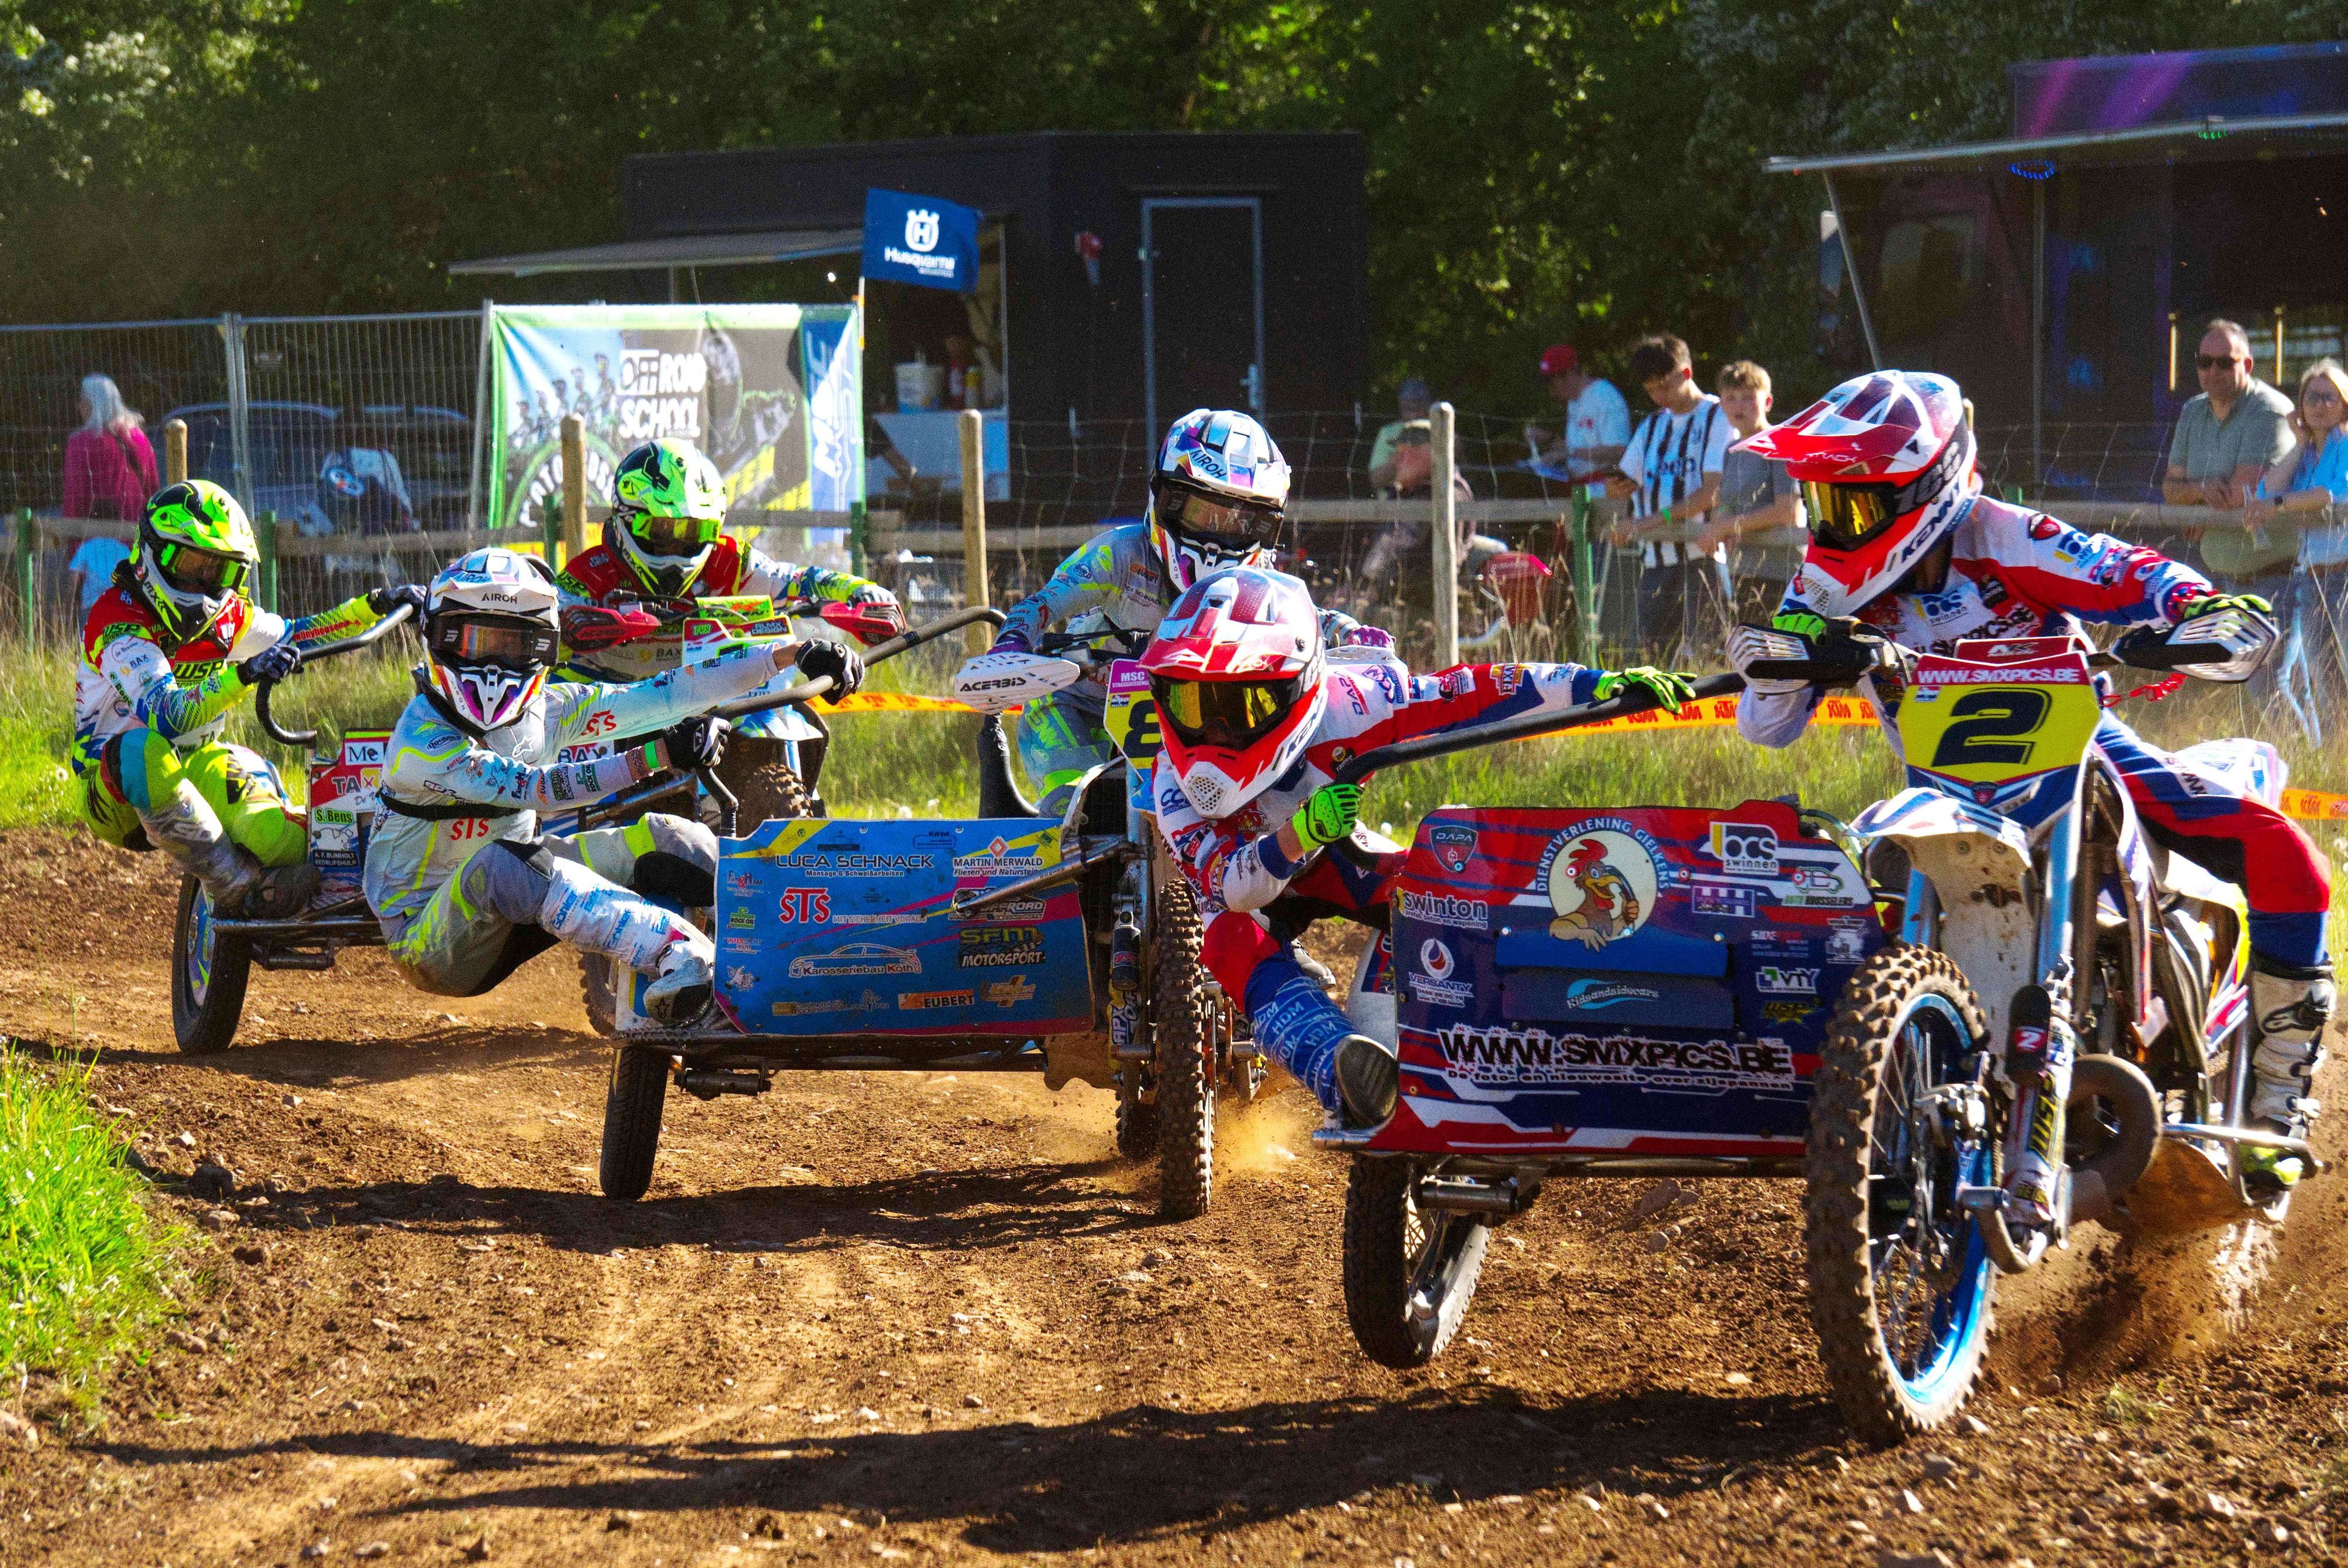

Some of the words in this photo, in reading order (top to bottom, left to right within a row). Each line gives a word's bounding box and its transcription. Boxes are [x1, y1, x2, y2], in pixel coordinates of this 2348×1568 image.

[885, 246, 956, 271] Husqvarna
[1191, 450, 1227, 478] AIROH
[481, 593, 517, 604] AIROH
[1120, 671, 1145, 682] MSC
[1918, 668, 2080, 683] WWW.SMXPICS.BE
[960, 677, 1026, 692] ACERBIS
[1931, 688, 2052, 768] 2
[326, 809, 353, 823] Bens
[1436, 833, 1473, 842] DAPA
[776, 855, 831, 868] LUCA
[837, 854, 934, 868] SCHNACK
[1537, 817, 1633, 891] DIENSTVERLENING
[953, 858, 991, 867] MARTIN
[993, 857, 1043, 867] MERWALD
[1725, 860, 1778, 869] swinnen
[806, 870, 836, 878] Montage
[953, 869, 980, 877] Fliesen
[982, 868, 998, 876] und
[780, 887, 831, 924] STS
[1404, 892, 1488, 920] swinton
[834, 915, 846, 924] MIT
[848, 915, 892, 923] SICHERHEIT
[1423, 914, 1441, 922] beton
[1453, 918, 1487, 929] wapening
[962, 952, 1043, 967] MOTORSPORT
[803, 966, 885, 976] Karosseriebau
[887, 964, 913, 974] Köth
[1272, 1002, 1305, 1035] HDM
[1440, 1029, 1793, 1074] WWW.SMXPICS.BE
[1448, 1070, 1468, 1080] De
[1522, 1073, 1545, 1082] en
